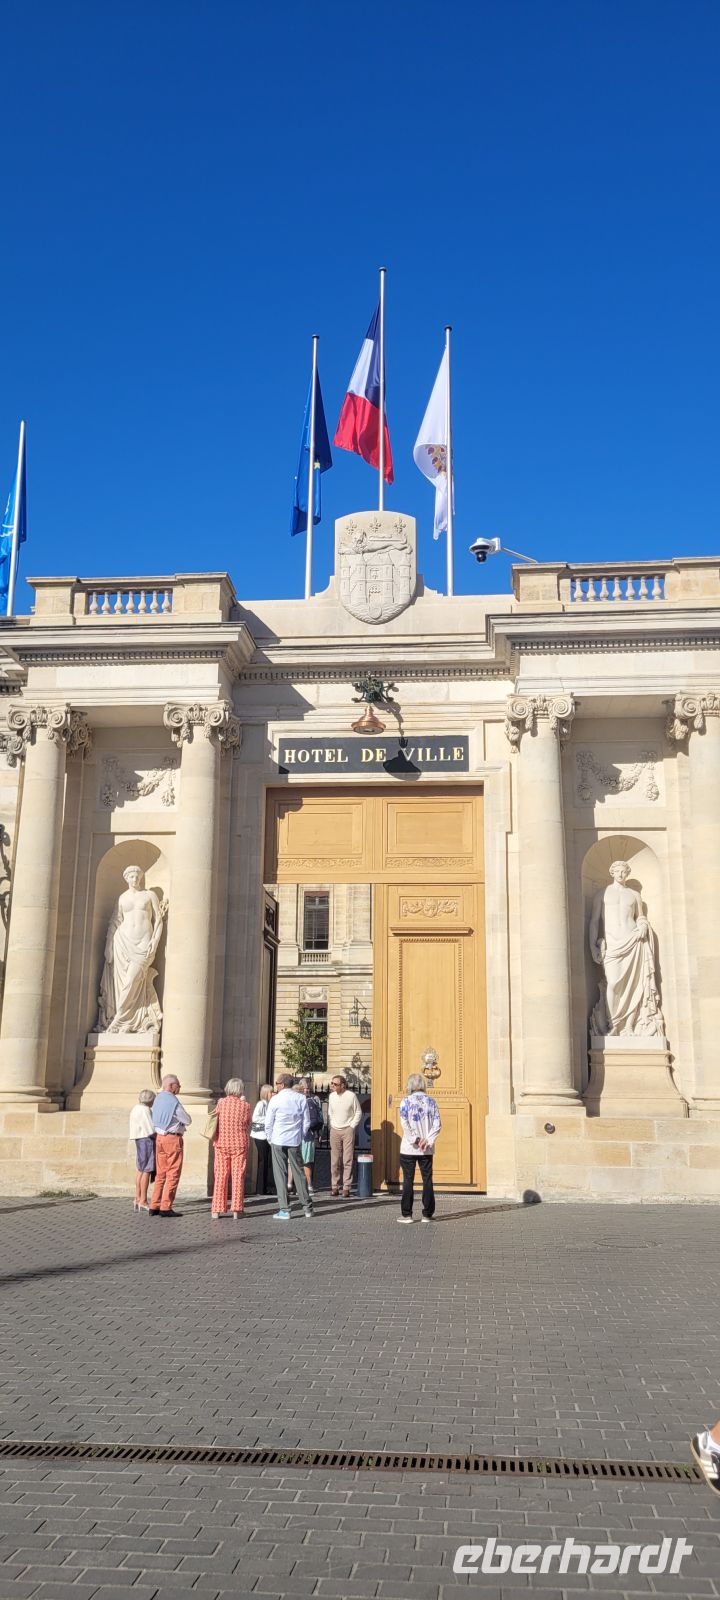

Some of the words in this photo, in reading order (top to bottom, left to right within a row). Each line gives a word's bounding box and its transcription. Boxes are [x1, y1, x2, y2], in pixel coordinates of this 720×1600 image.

[284, 748, 348, 764] HOTEL
[361, 748, 387, 763] DE
[401, 746, 464, 761] VILLE
